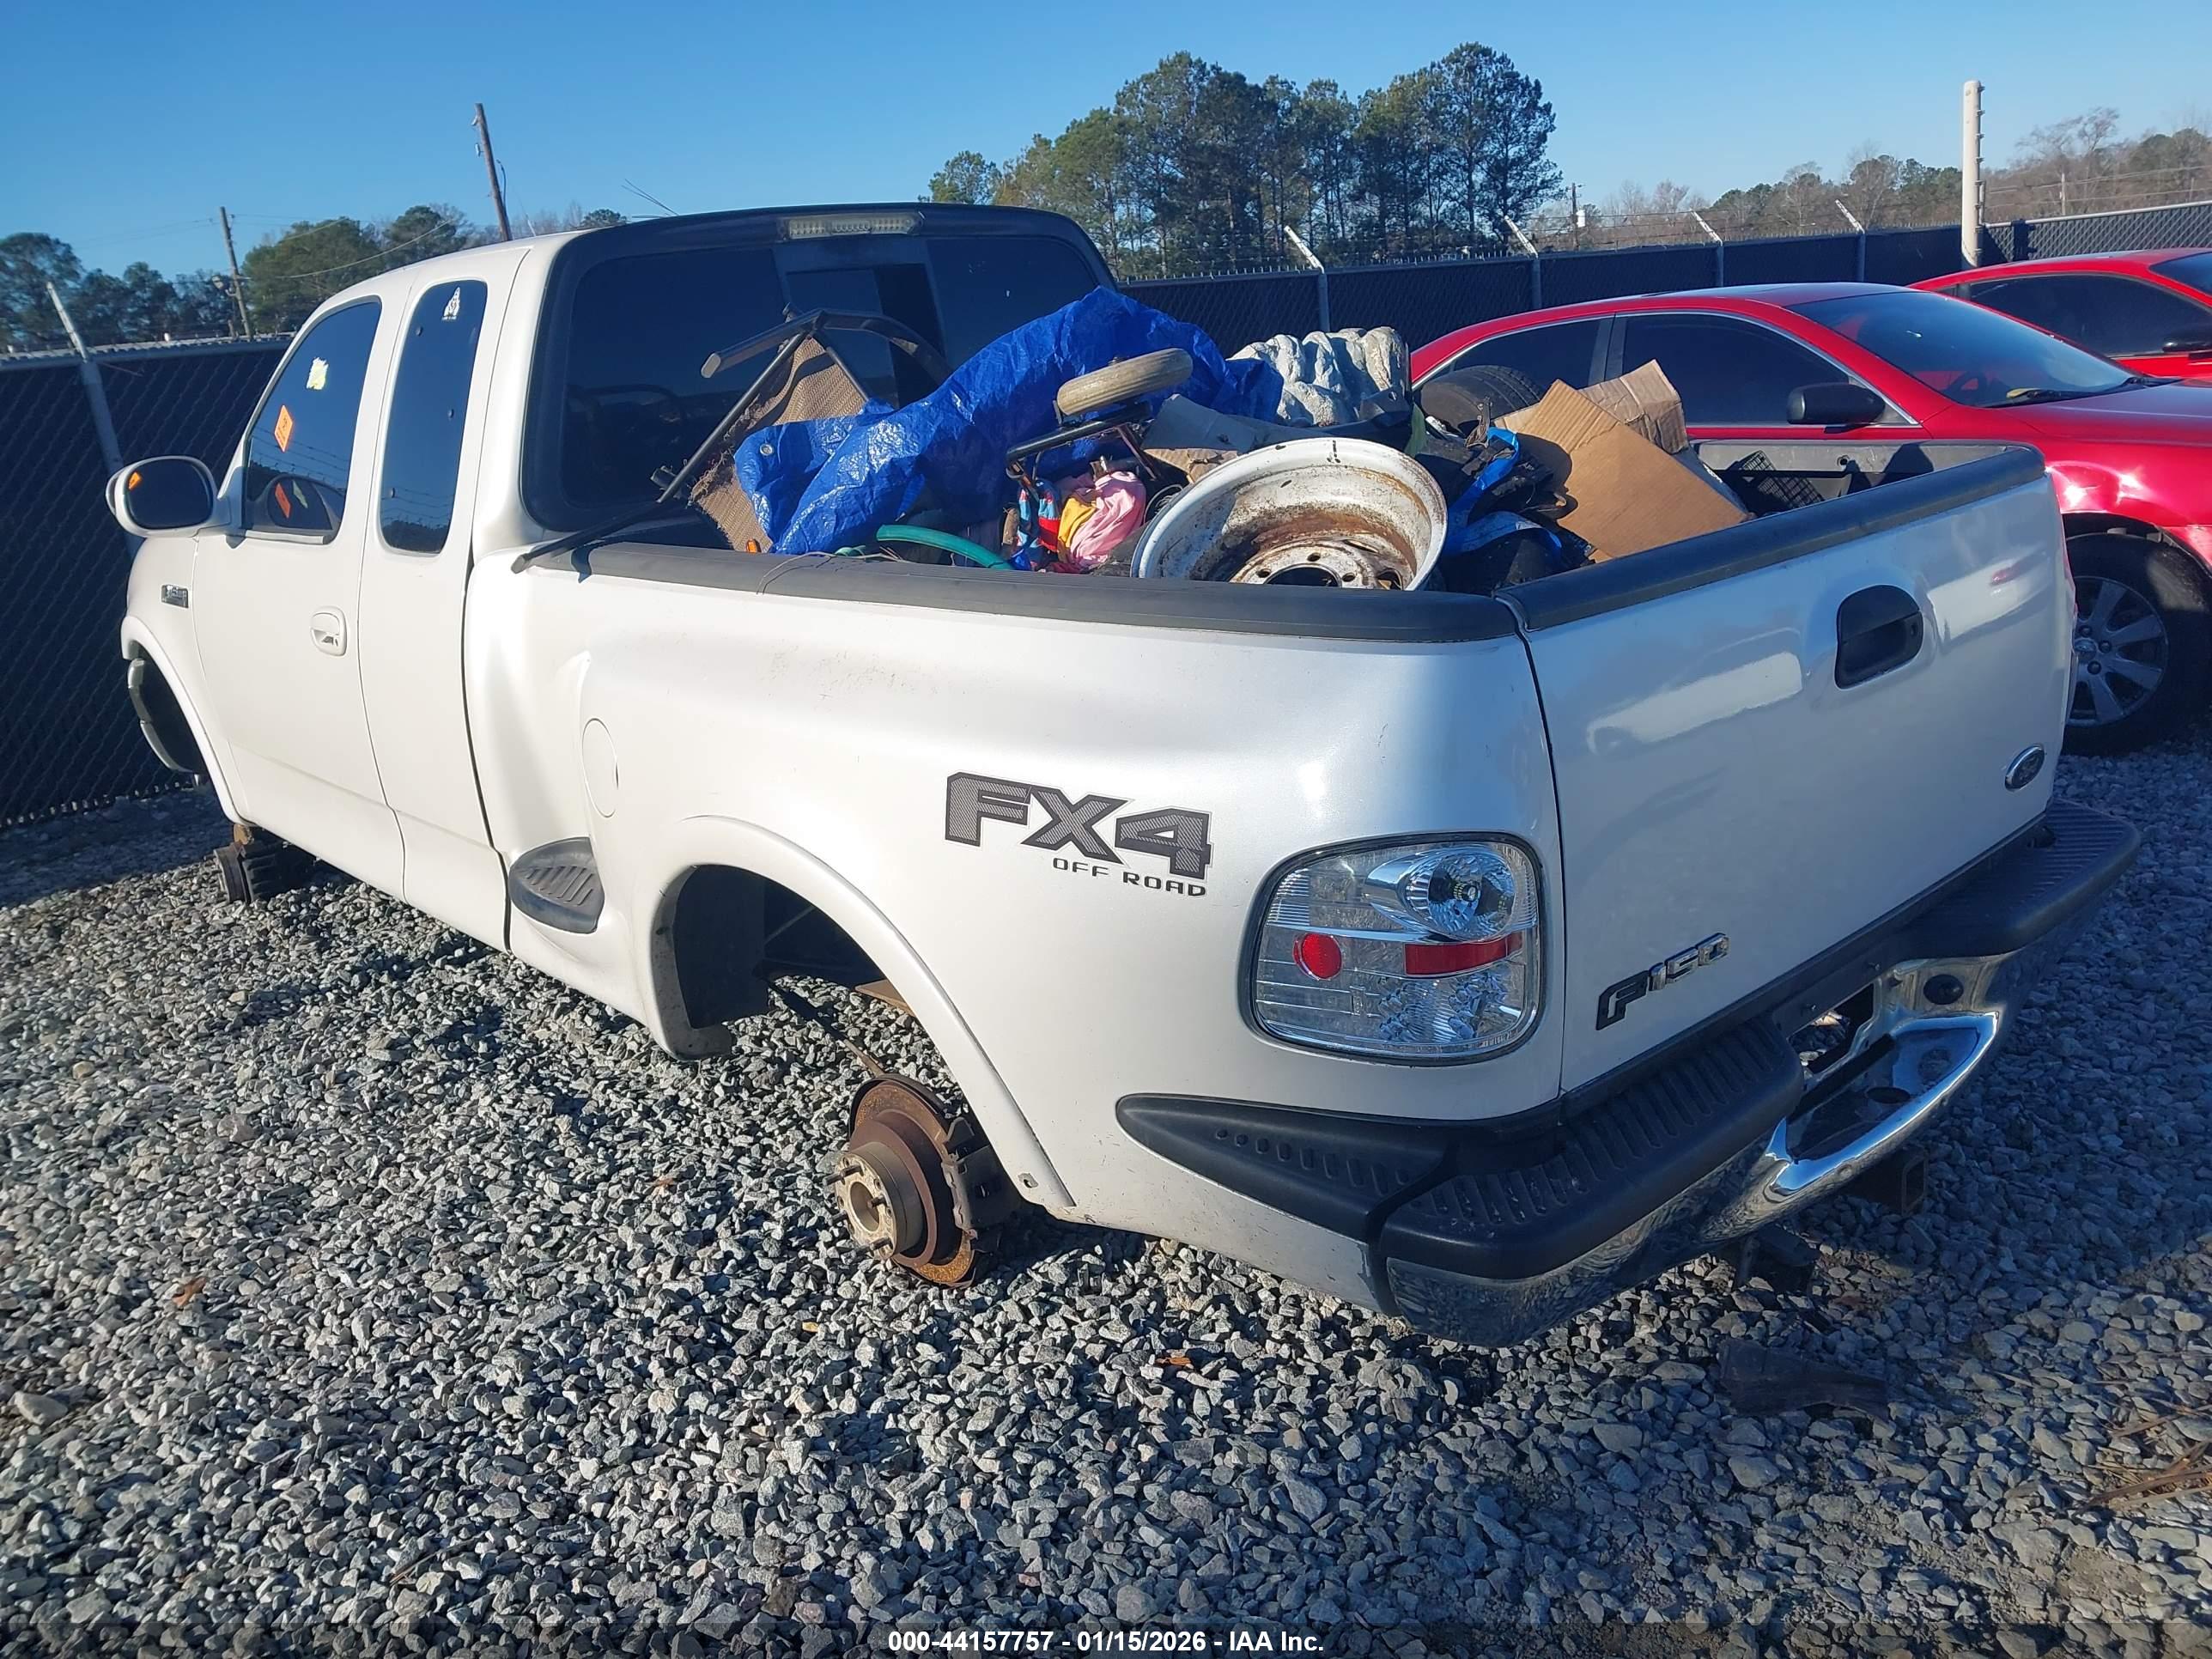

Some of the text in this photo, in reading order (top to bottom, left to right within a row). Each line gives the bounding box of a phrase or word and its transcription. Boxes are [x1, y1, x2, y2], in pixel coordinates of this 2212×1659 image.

[945, 770, 1212, 880] FX4
[1052, 857, 1206, 897] OFF ROAD
[1595, 932, 1731, 1031] F150
